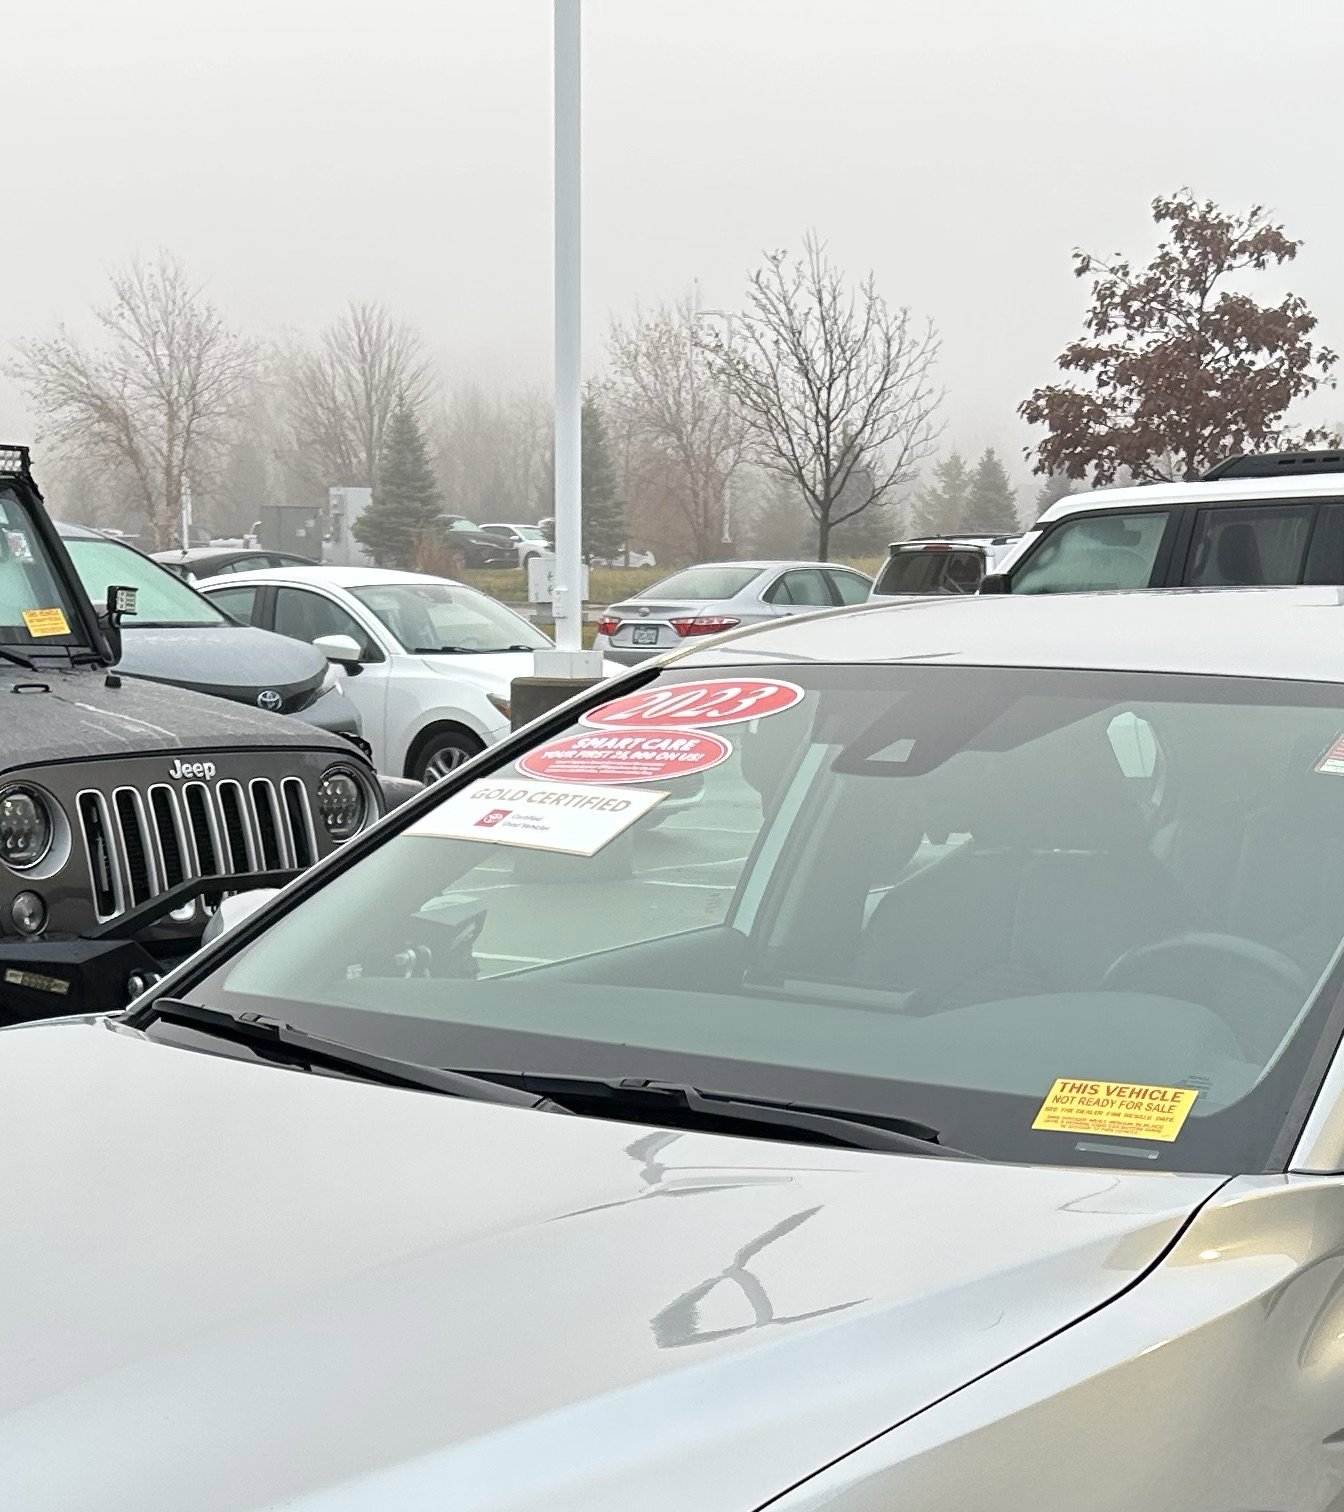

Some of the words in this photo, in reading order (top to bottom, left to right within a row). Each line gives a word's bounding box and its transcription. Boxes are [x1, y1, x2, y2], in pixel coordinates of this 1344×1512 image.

[605, 685, 779, 721] 2023
[572, 737, 644, 750] SMART
[641, 738, 701, 752] CARE
[575, 750, 614, 760] FIRST
[169, 759, 216, 780] Jeep
[470, 788, 528, 802] GOLD
[526, 791, 632, 813] CERTIFIED
[1059, 1081, 1101, 1095] THIS
[1106, 1085, 1185, 1103] VEHICLE
[1052, 1095, 1077, 1105] NOT
[1077, 1096, 1117, 1109] READY
[1118, 1100, 1144, 1110] FOR
[1145, 1102, 1177, 1114] SALE
